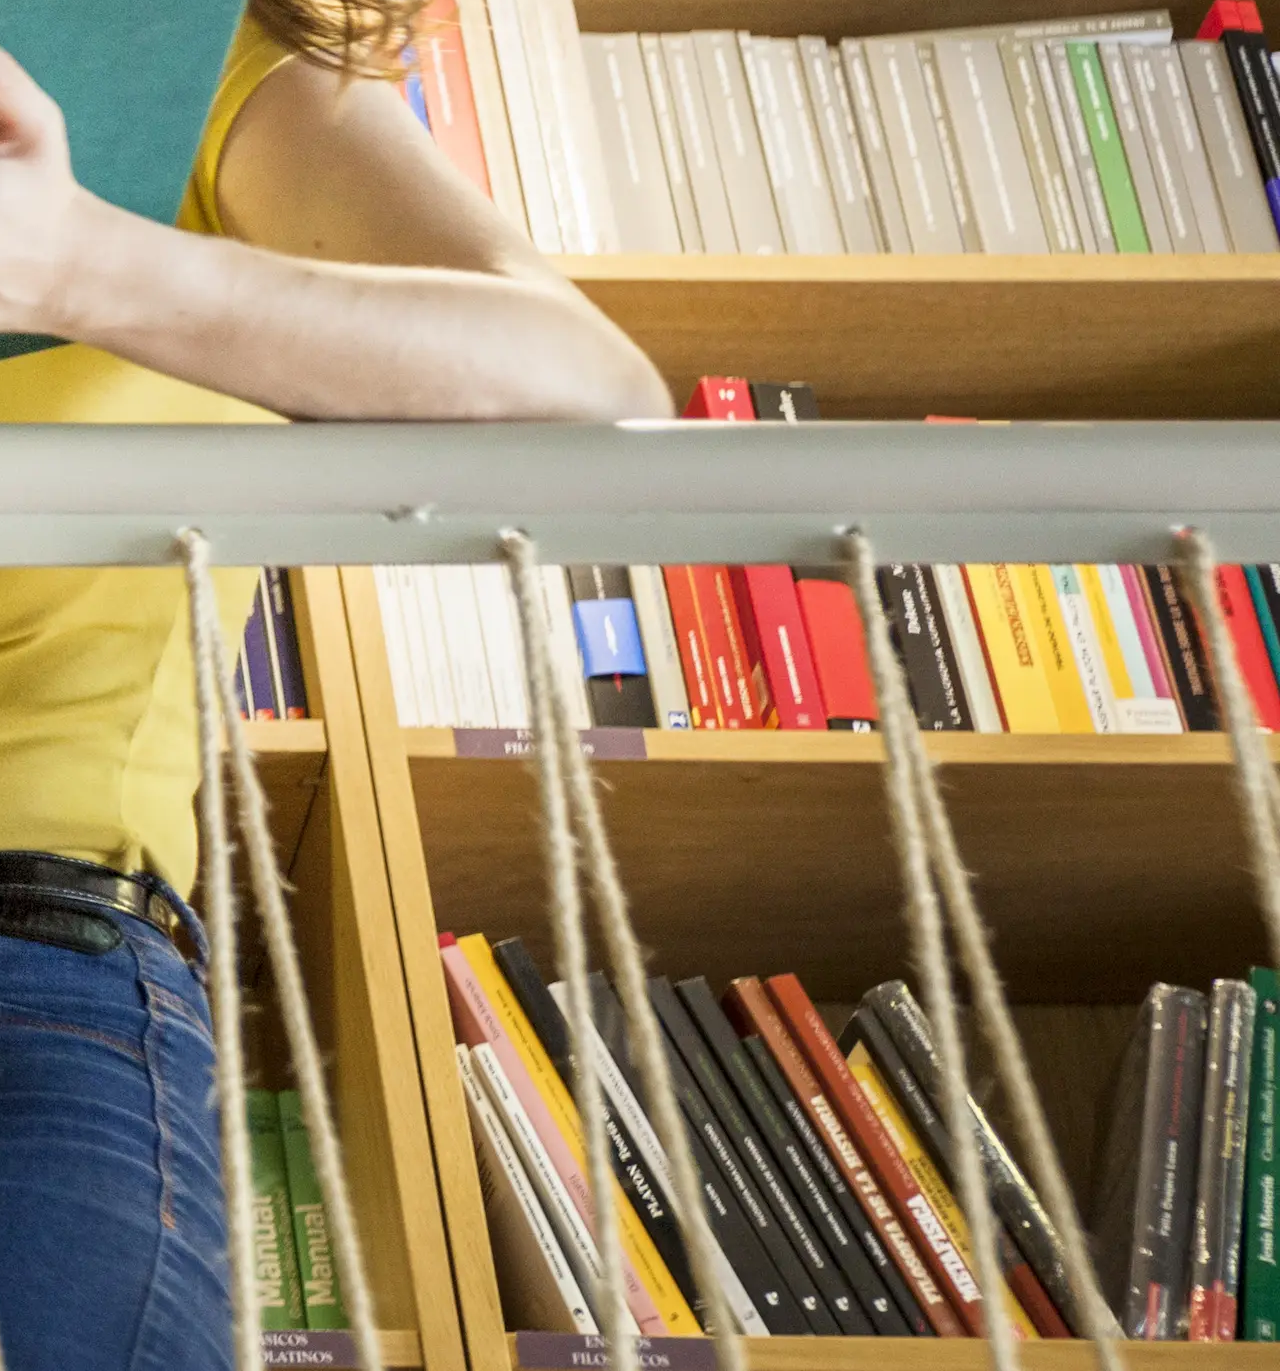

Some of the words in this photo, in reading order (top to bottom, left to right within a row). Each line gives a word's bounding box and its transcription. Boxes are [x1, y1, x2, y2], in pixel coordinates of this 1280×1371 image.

[809, 1093, 862, 1170] HISTORIA
[624, 1162, 665, 1219] PLATON
[854, 1169, 877, 1196] LA
[867, 1192, 891, 1221] DE
[1256, 1173, 1274, 1230] Mosterín
[294, 1202, 336, 1307] Manual
[1257, 1230, 1276, 1265] Jesús
